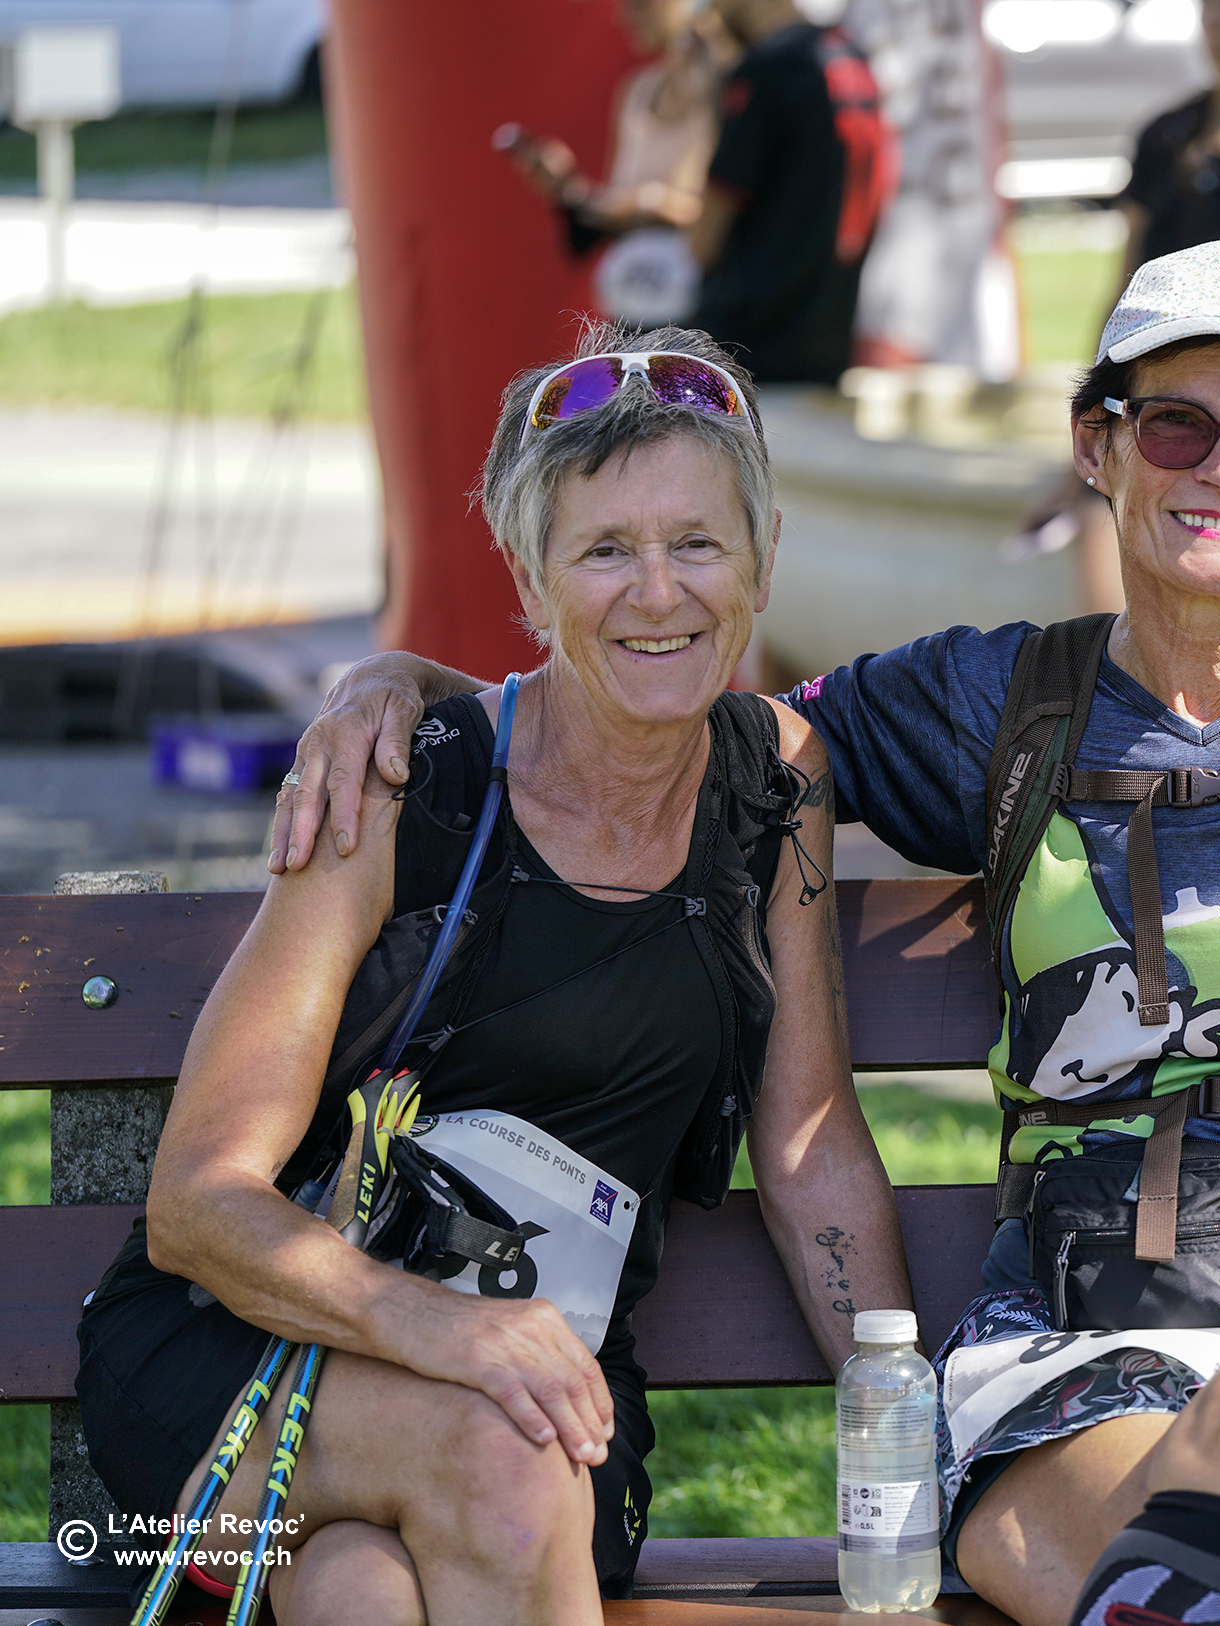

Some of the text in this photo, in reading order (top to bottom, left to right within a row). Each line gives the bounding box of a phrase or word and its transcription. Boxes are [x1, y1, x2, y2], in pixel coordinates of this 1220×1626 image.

[988, 751, 1034, 878] DAKINE
[445, 1115, 587, 1185] LA COURSE DES PONTS
[357, 1162, 377, 1224] LEKI
[591, 1197, 608, 1216] AXA
[484, 1241, 521, 1263] LE
[210, 1379, 271, 1485] LEKI
[267, 1392, 311, 1500] LEKI
